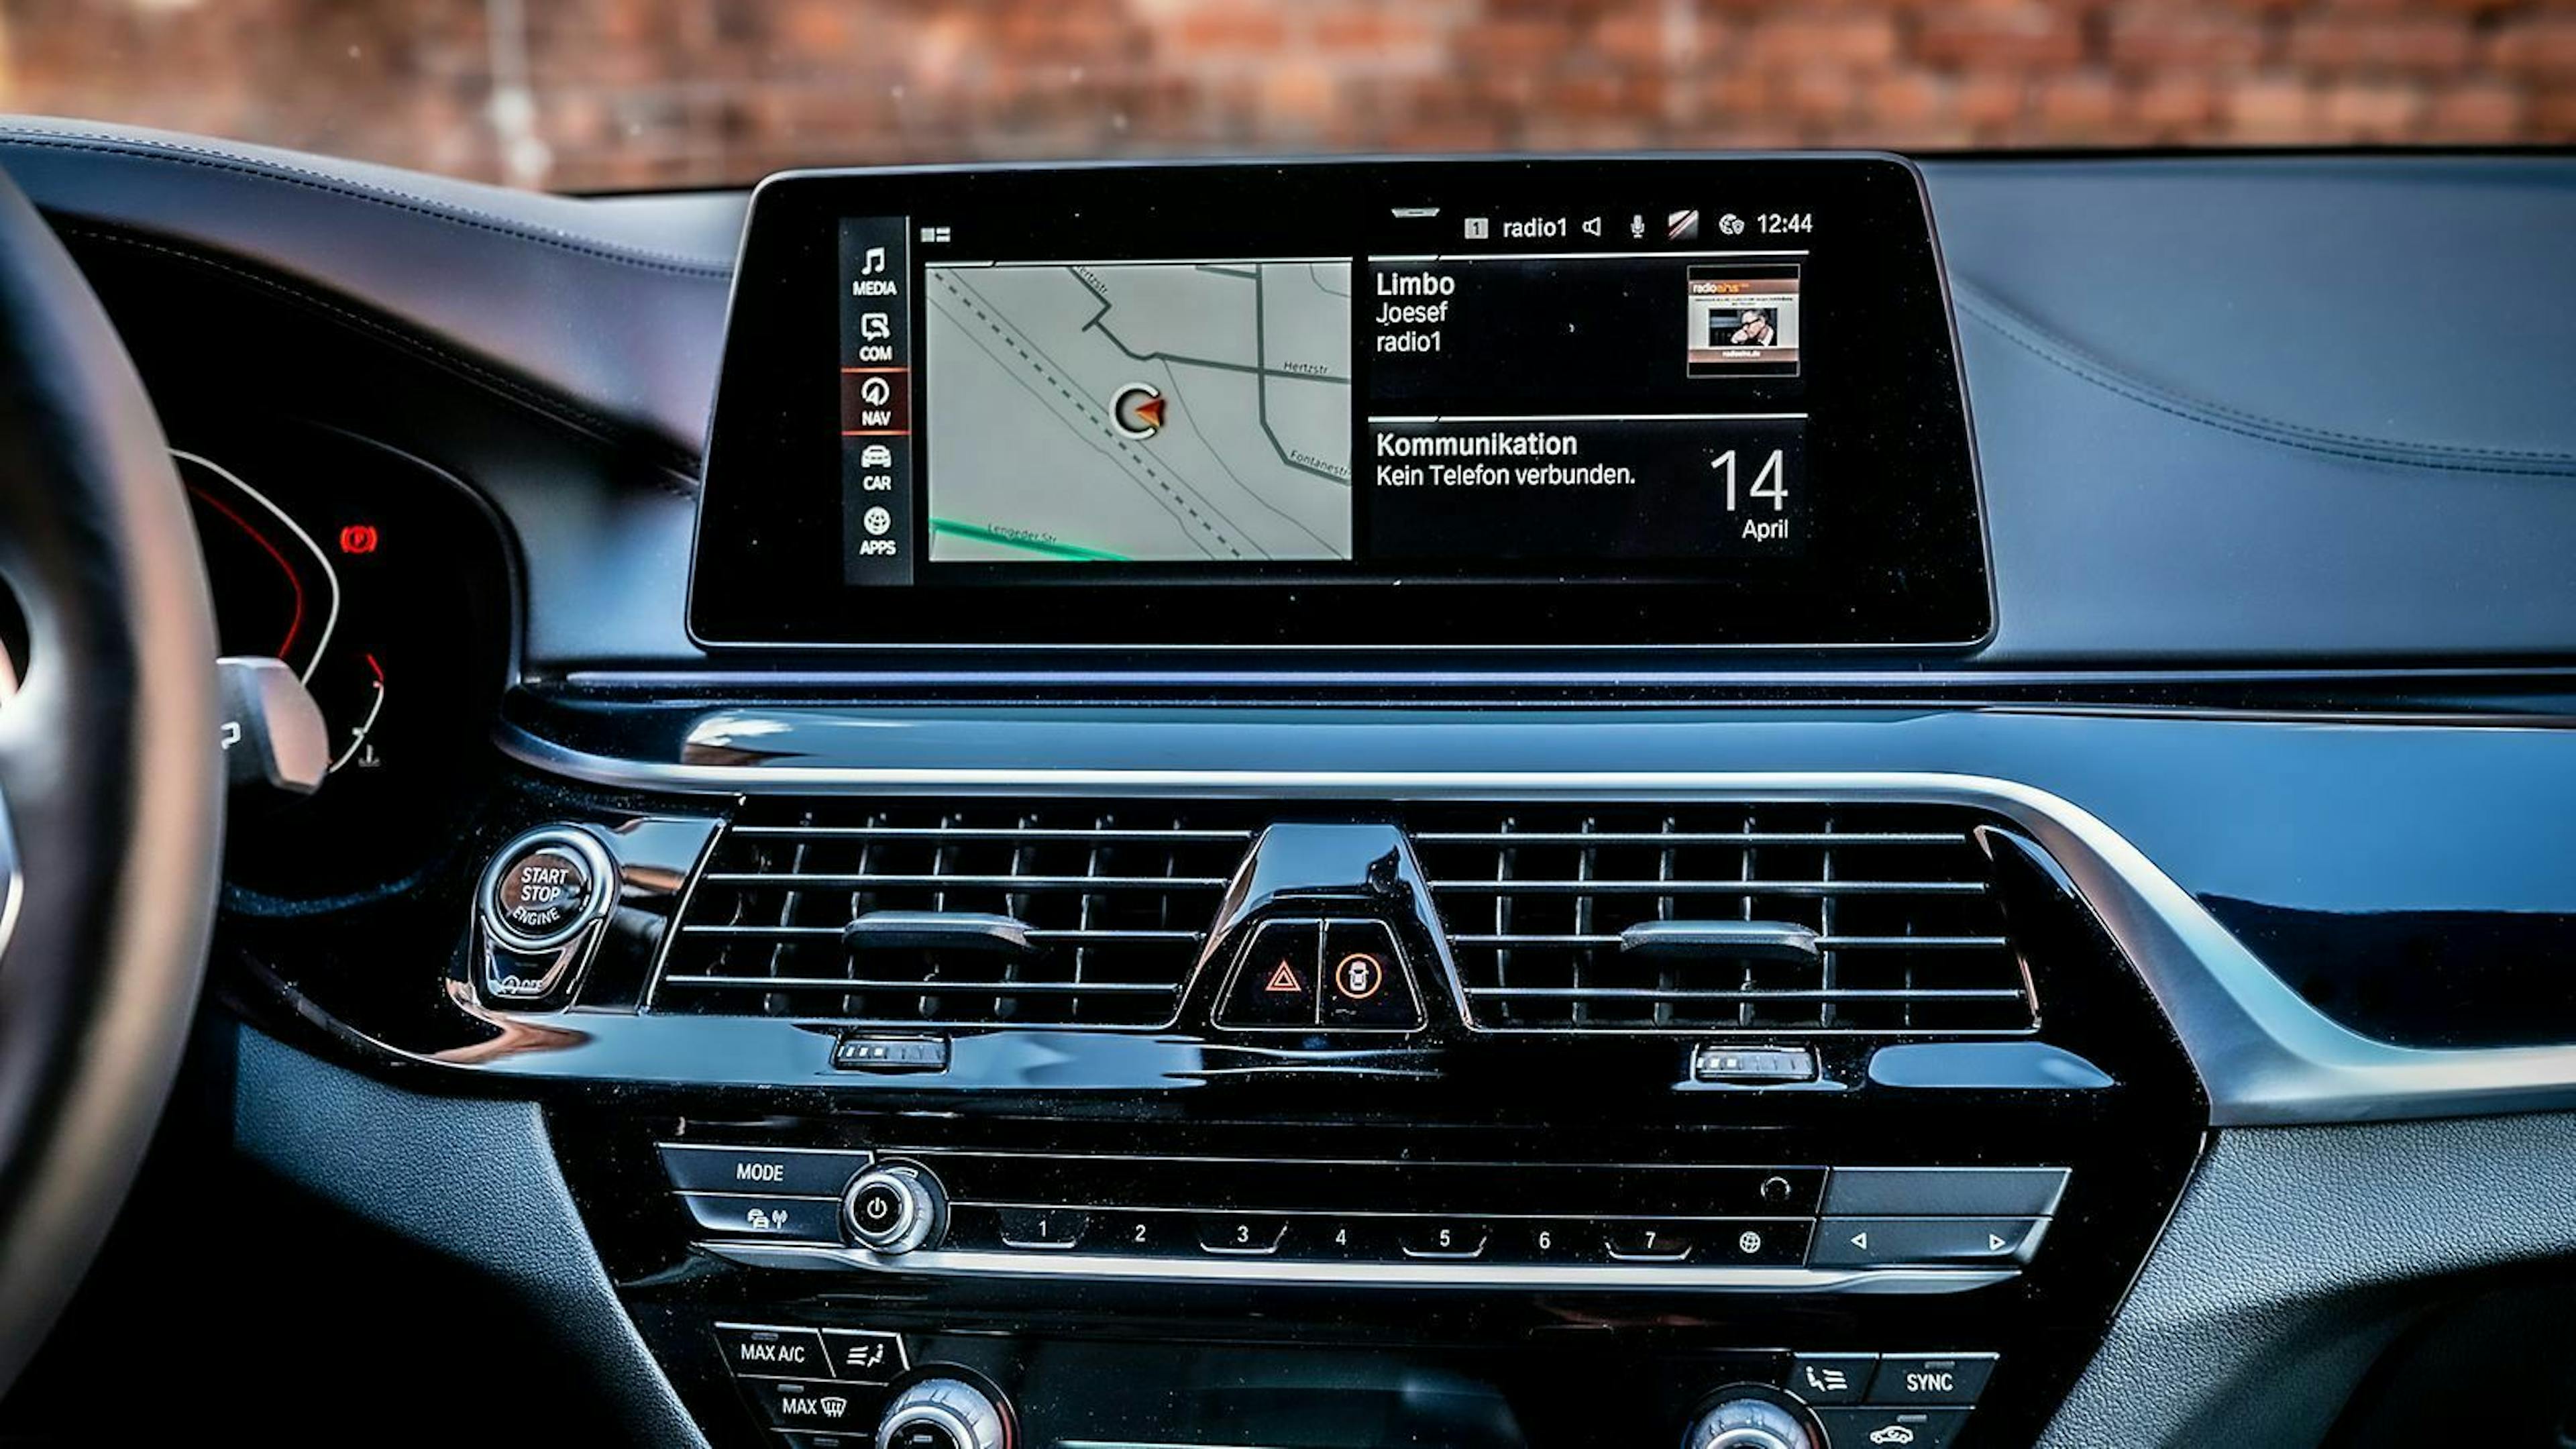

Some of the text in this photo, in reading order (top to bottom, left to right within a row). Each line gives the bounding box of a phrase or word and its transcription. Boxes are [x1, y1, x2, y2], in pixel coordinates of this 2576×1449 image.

[1504, 217, 1566, 237] radio1
[1757, 213, 1813, 233] 12:44
[853, 280, 898, 296] MEDIA
[1078, 266, 1108, 293] ertzstr
[1377, 271, 1455, 296] Limbo
[1375, 300, 1449, 323] Joesef
[1377, 331, 1440, 352] radio1
[859, 345, 892, 362] COM
[862, 411, 892, 426] NAV
[1377, 432, 1577, 457] Kommunikation
[863, 475, 892, 490] CAR
[1377, 463, 1635, 486] Kein Telefon verbunden.
[1711, 449, 1788, 511] 14
[1742, 519, 1788, 542] April
[859, 540, 896, 555] APPS
[521, 866, 570, 884] START
[521, 885, 561, 902] STOP
[513, 906, 561, 926] ENGINE
[736, 1163, 784, 1181] MODE
[1039, 1220, 1046, 1237] 1
[1135, 1224, 1146, 1242] 2
[1237, 1225, 1248, 1242] 3
[1336, 1229, 1346, 1245] 4
[1440, 1229, 1450, 1247] 5
[1540, 1231, 1550, 1249] 6
[1646, 1232, 1656, 1249] 7
[741, 1344, 804, 1363] MAX A/C
[1907, 1373, 1953, 1392] SYNC
[783, 1398, 817, 1415] MAX
